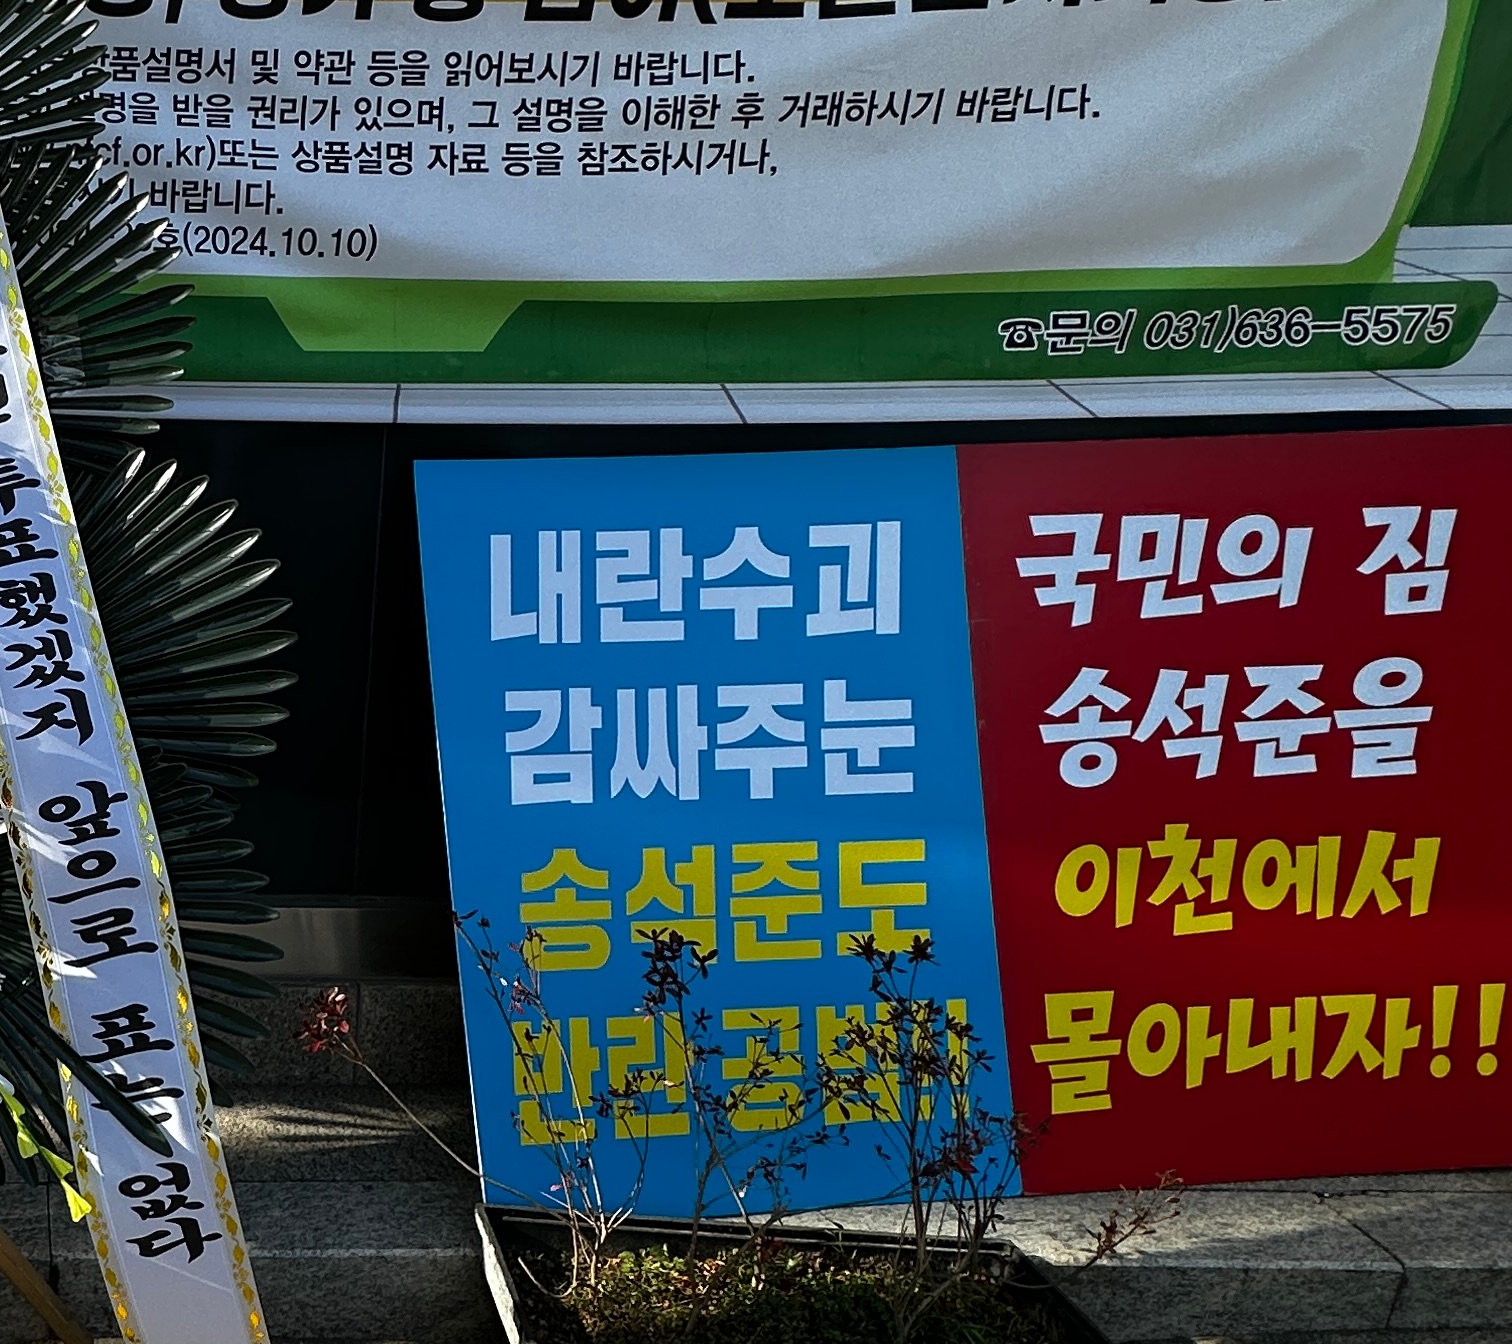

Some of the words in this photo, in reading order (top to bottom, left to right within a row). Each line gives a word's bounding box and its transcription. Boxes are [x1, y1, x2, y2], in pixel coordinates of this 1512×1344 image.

[172, 92, 235, 129] 받을
[246, 94, 341, 131] 권리가
[354, 96, 456, 134] 있으며,
[467, 99, 500, 129] 그
[513, 96, 609, 133] 설명을
[622, 93, 720, 132] 이해한
[730, 93, 765, 130] 후
[778, 88, 944, 130] 거래하시기
[956, 84, 1102, 123] 바랍니다.
[250, 48, 280, 86] 및
[294, 49, 357, 87] 약관
[367, 50, 431, 87] 등을
[444, 50, 602, 88] 읽어보시기
[613, 48, 756, 88] 바랍니다.
[150, 178, 284, 216] 바랍니다.
[291, 140, 415, 176] 상품설명
[427, 141, 487, 176] 자료
[501, 141, 566, 177] 등을
[577, 138, 778, 178] 참조하시거나,
[1046, 309, 1138, 356] 문의
[1144, 303, 1457, 354] 031)636-5575
[490, 521, 902, 644] 내란수괴
[1015, 513, 1314, 628] 국민의
[1356, 505, 1458, 615] 짐
[504, 679, 916, 805] 감싸주눈
[1039, 656, 1434, 788] 송석준을
[519, 838, 931, 972] 송석준도
[1054, 823, 1441, 936] 이천에서
[38, 780, 159, 967] 앞으로
[118, 1162, 223, 1263] 없다
[1030, 983, 1506, 1115] 몰아내자!!
